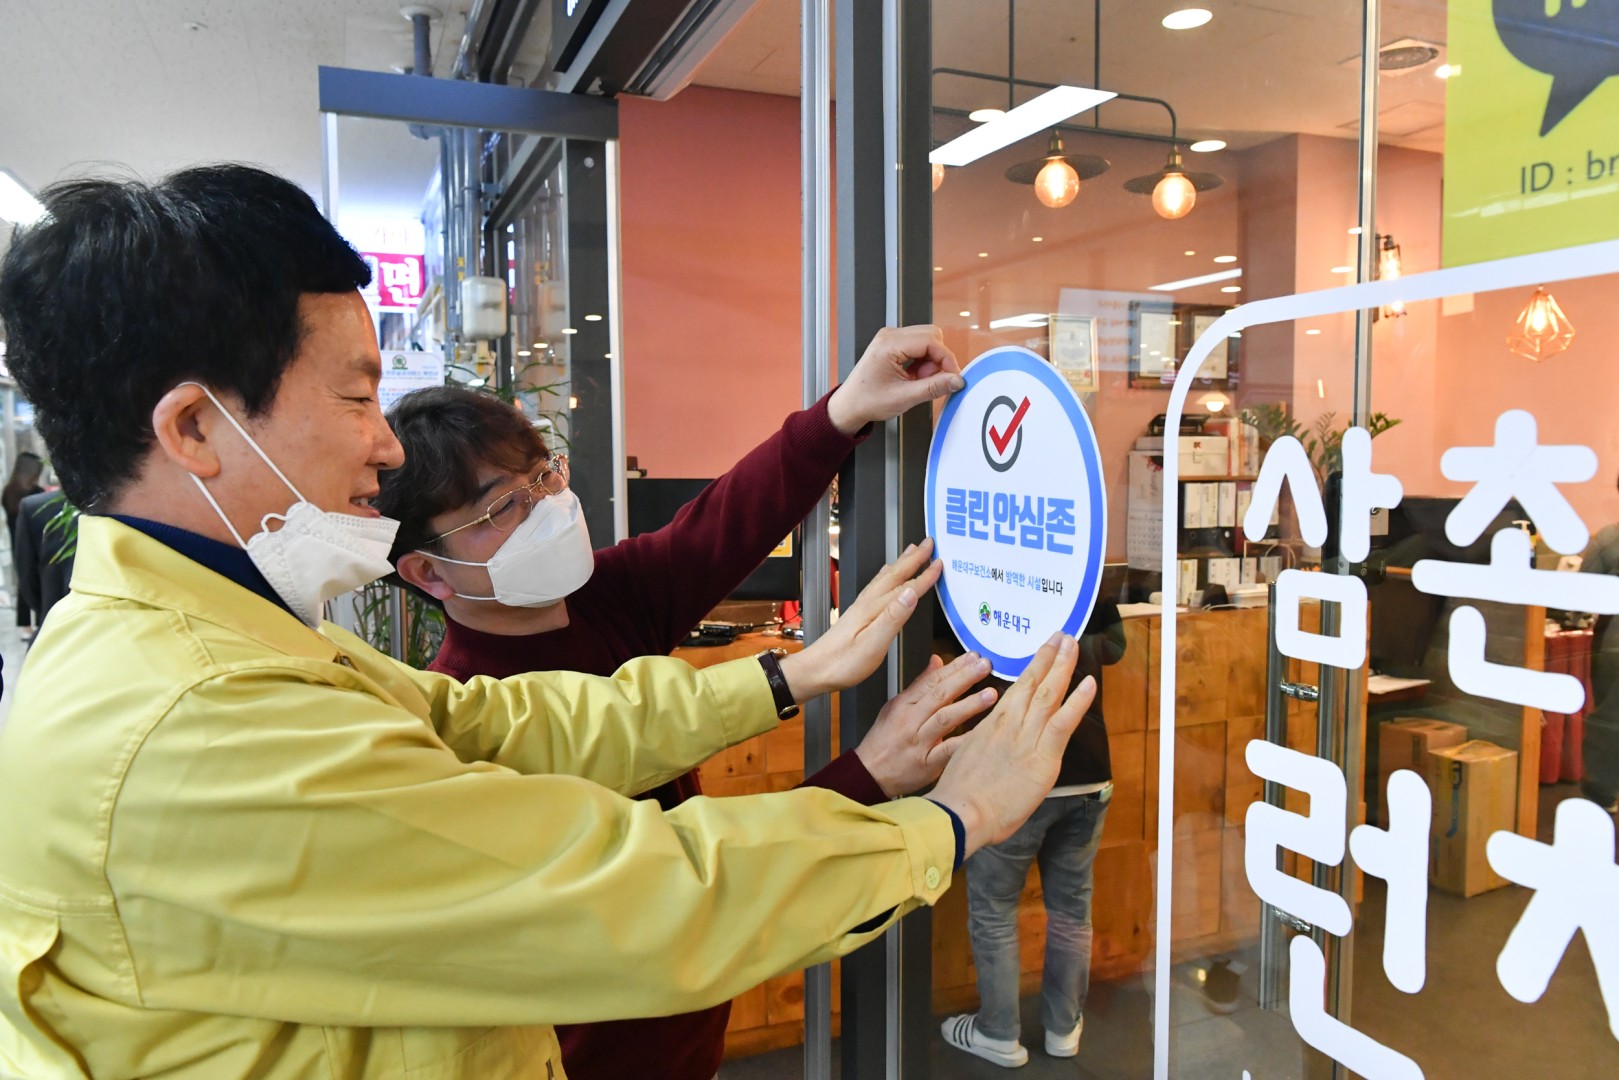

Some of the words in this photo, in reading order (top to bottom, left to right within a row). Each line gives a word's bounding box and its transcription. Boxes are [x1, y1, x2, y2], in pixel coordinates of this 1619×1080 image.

[1520, 162, 1554, 194] ID
[951, 559, 1004, 583] 해운대구보건소에서
[1005, 570, 1026, 587] 방역한
[1027, 575, 1064, 596] 시설입니다
[993, 609, 1031, 635] 해운대구
